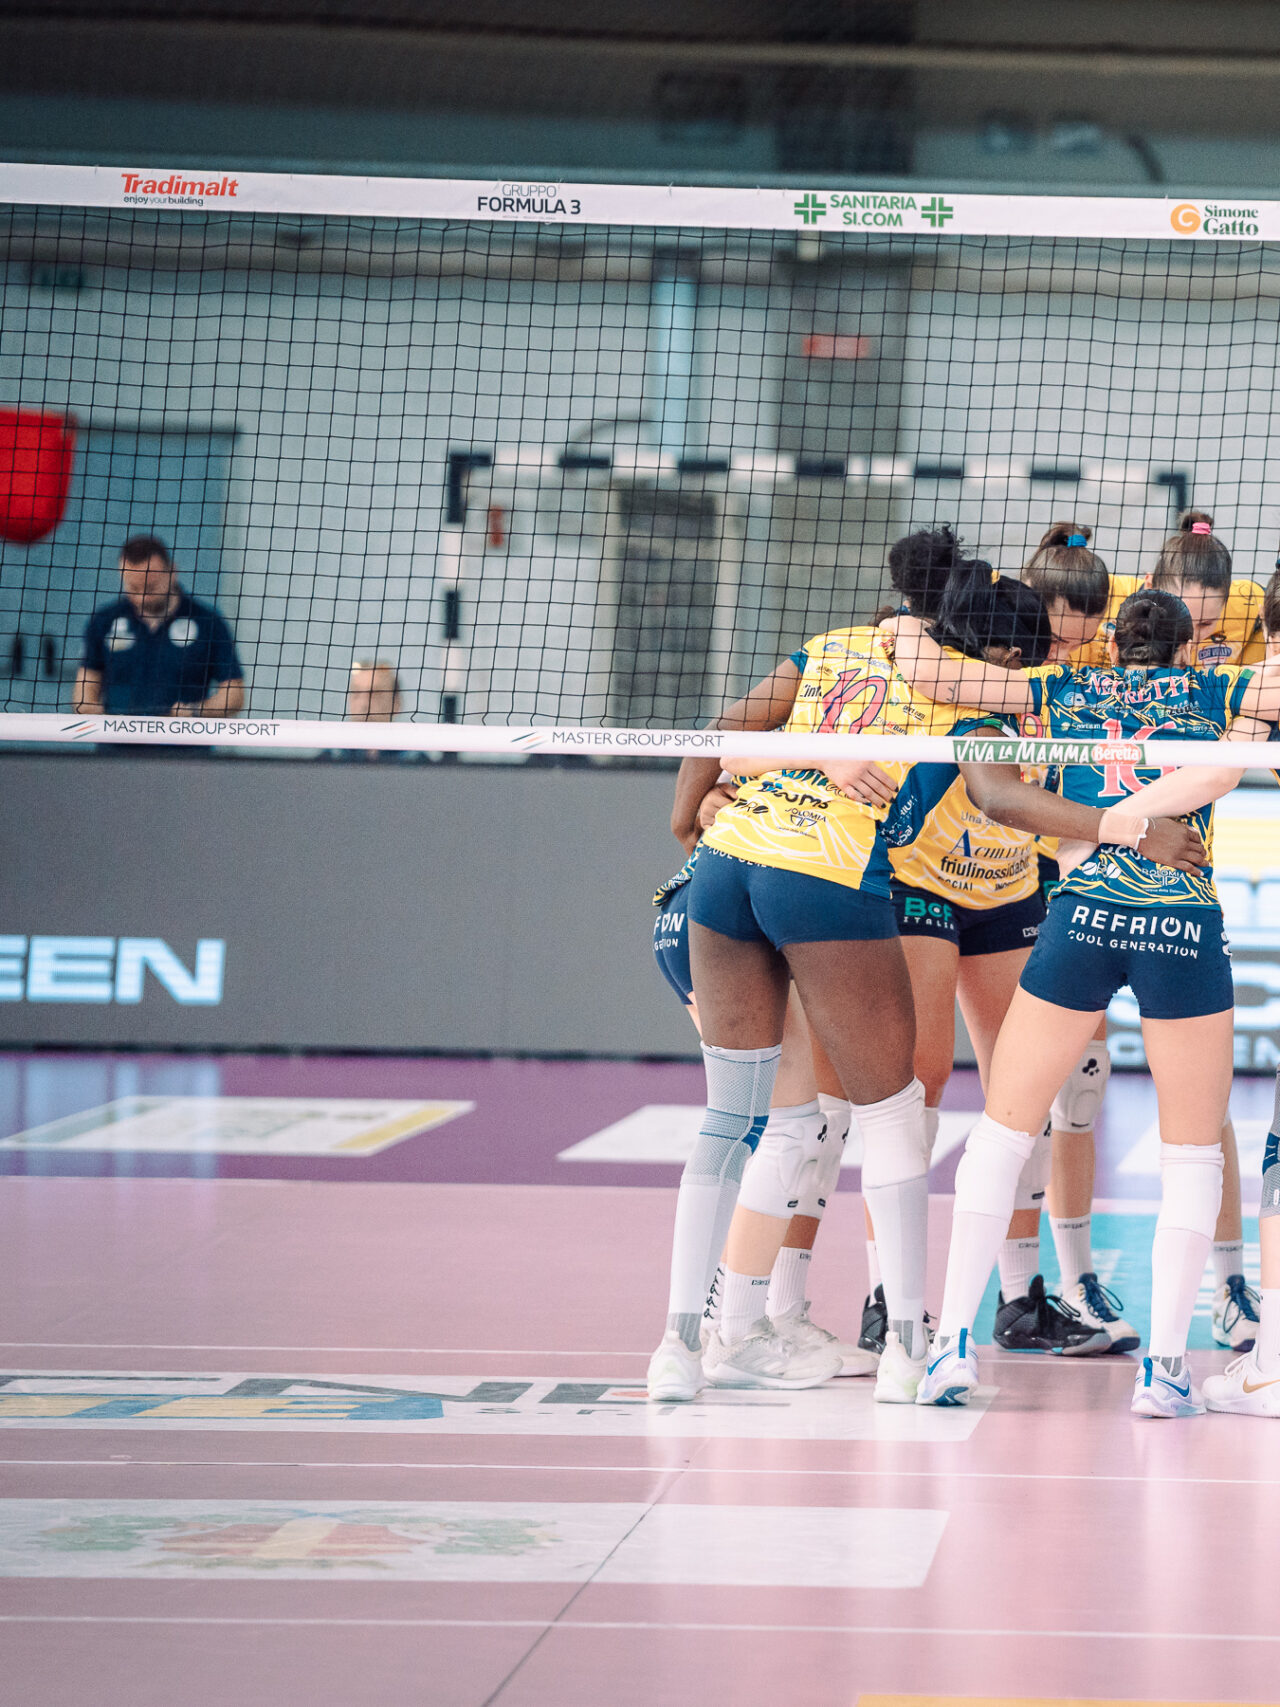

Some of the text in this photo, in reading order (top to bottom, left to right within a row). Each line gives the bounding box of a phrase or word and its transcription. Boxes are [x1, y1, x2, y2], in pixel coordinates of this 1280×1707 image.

[121, 173, 239, 197] Tradimalt
[501, 184, 557, 198] GRUPPO
[477, 196, 581, 215] FORMULA 3
[830, 194, 917, 211] SANITARIA
[1204, 204, 1259, 218] Simone
[842, 211, 903, 227] SI.COM
[1203, 218, 1259, 236] Gatto
[104, 719, 280, 736] MASTER GROUP SPORT
[552, 731, 725, 748] MASTER GROUP SPORT
[1015, 740, 1089, 763] MAMMA
[1093, 744, 1140, 761] Beretta
[1071, 905, 1202, 943] REFRION
[1067, 929, 1199, 960] COOL GENERATION
